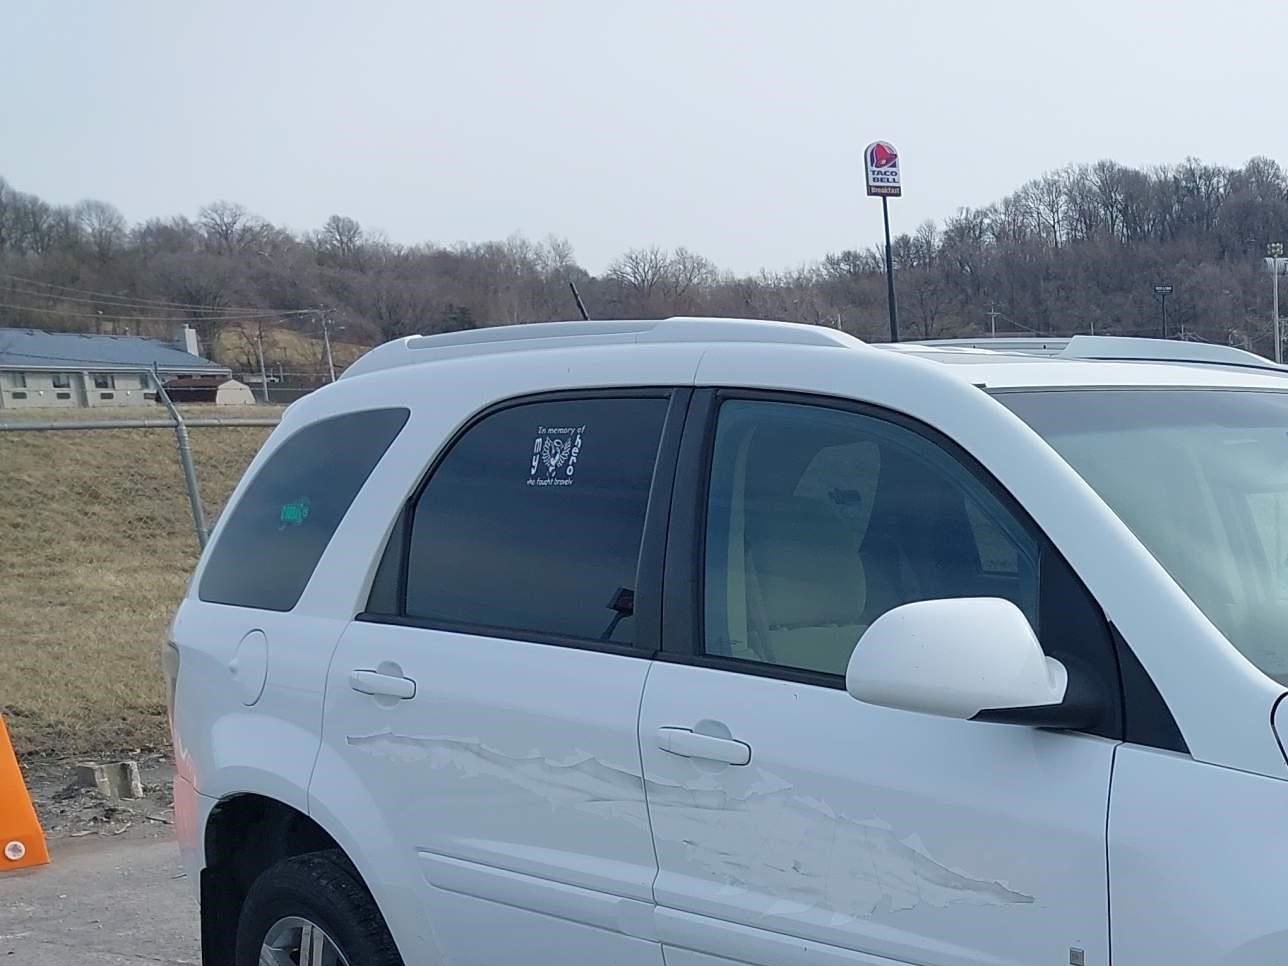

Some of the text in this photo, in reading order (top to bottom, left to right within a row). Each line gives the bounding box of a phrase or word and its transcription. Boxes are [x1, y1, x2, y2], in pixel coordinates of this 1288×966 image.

[538, 426, 546, 434] In
[547, 428, 576, 436] memory
[531, 437, 542, 475] my
[566, 434, 581, 476] hero
